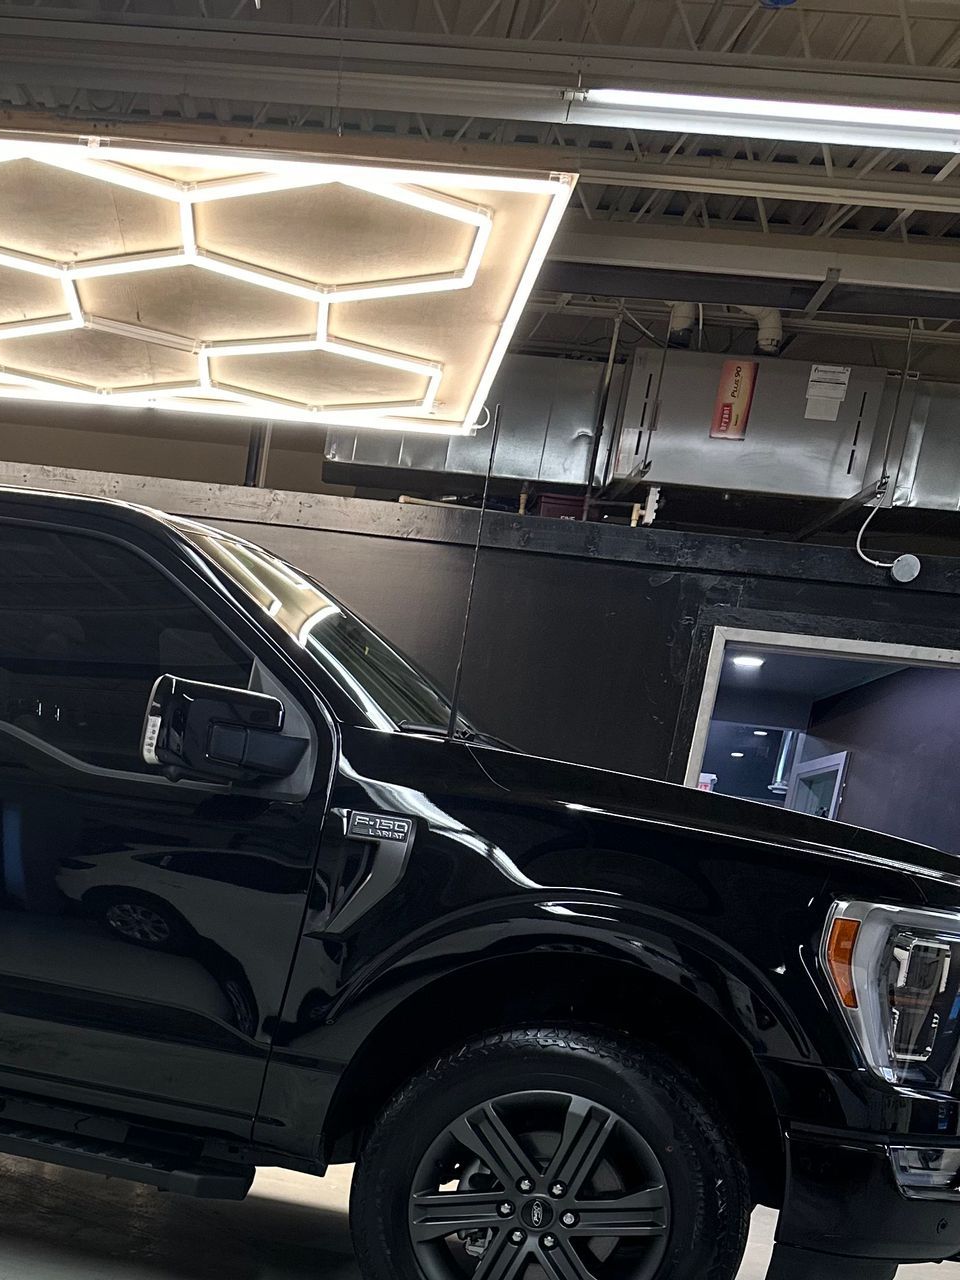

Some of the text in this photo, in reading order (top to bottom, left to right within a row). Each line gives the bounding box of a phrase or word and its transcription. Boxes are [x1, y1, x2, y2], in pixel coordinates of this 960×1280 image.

[735, 366, 742, 378] 90
[354, 816, 408, 833] F-150
[369, 828, 405, 840] LARIAT
